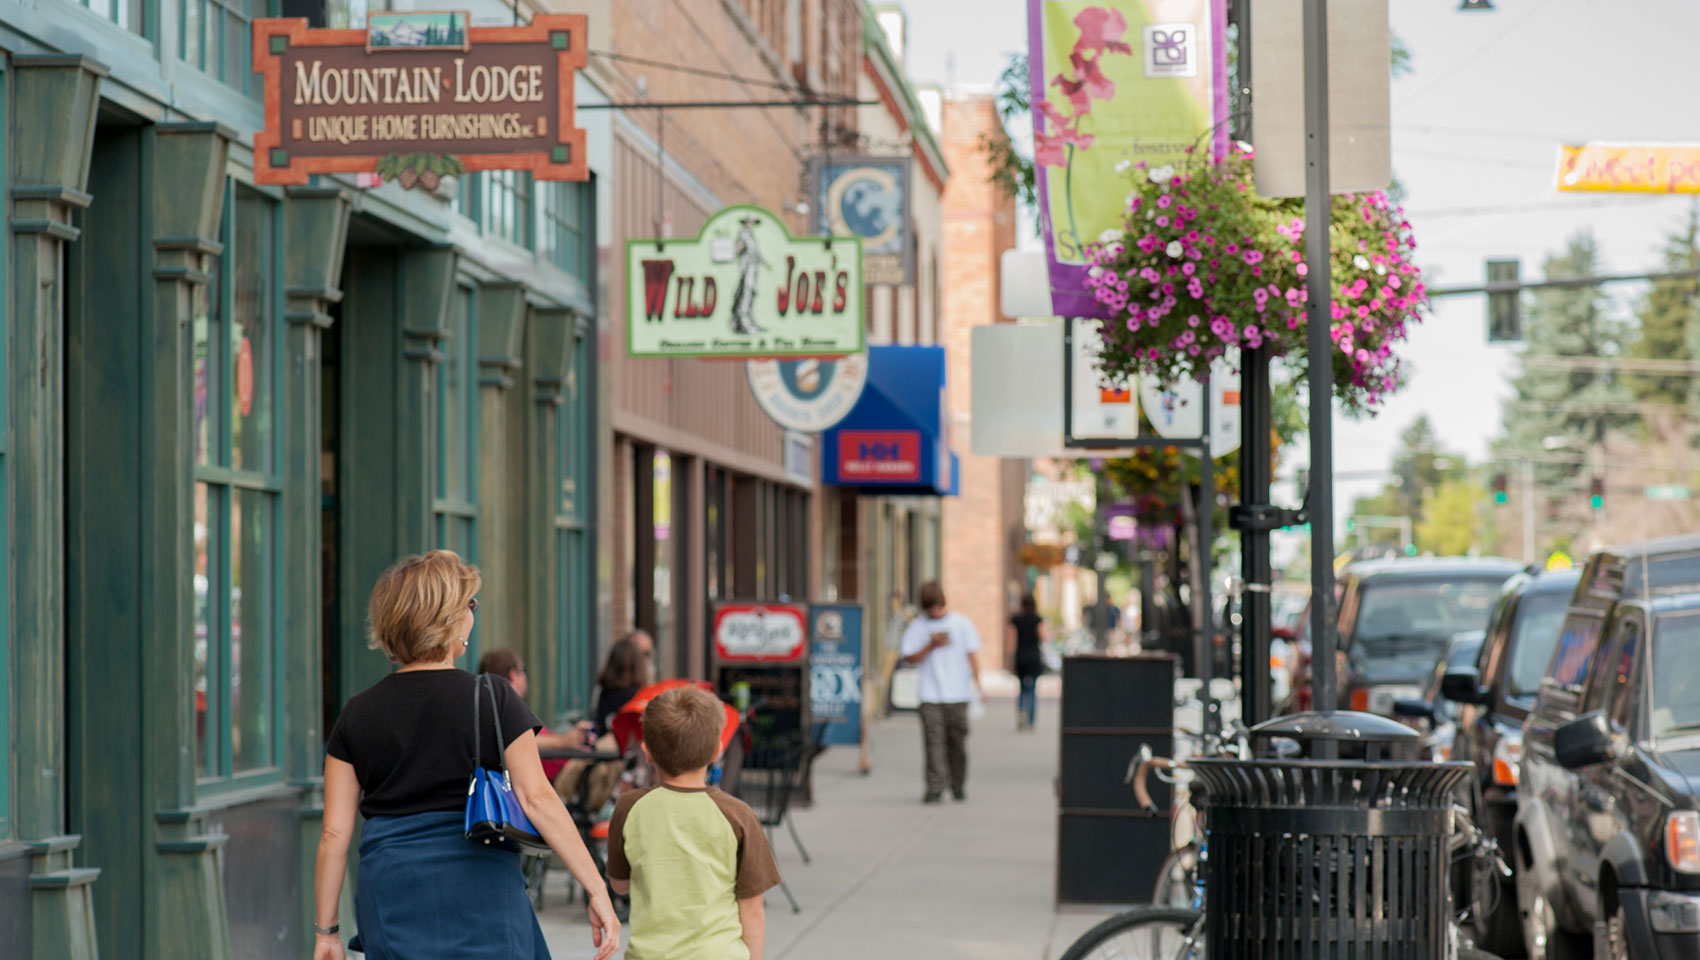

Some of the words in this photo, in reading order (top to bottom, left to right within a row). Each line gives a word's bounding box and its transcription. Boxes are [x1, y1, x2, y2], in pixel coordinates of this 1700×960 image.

[294, 60, 442, 105] MOUNTAIN
[453, 58, 544, 103] LODGE
[309, 116, 368, 144] UNIQUE
[372, 115, 417, 140] HOME
[420, 113, 520, 140] FURNISHINGS
[641, 259, 718, 322] WILD
[776, 255, 849, 317] JOE'S
